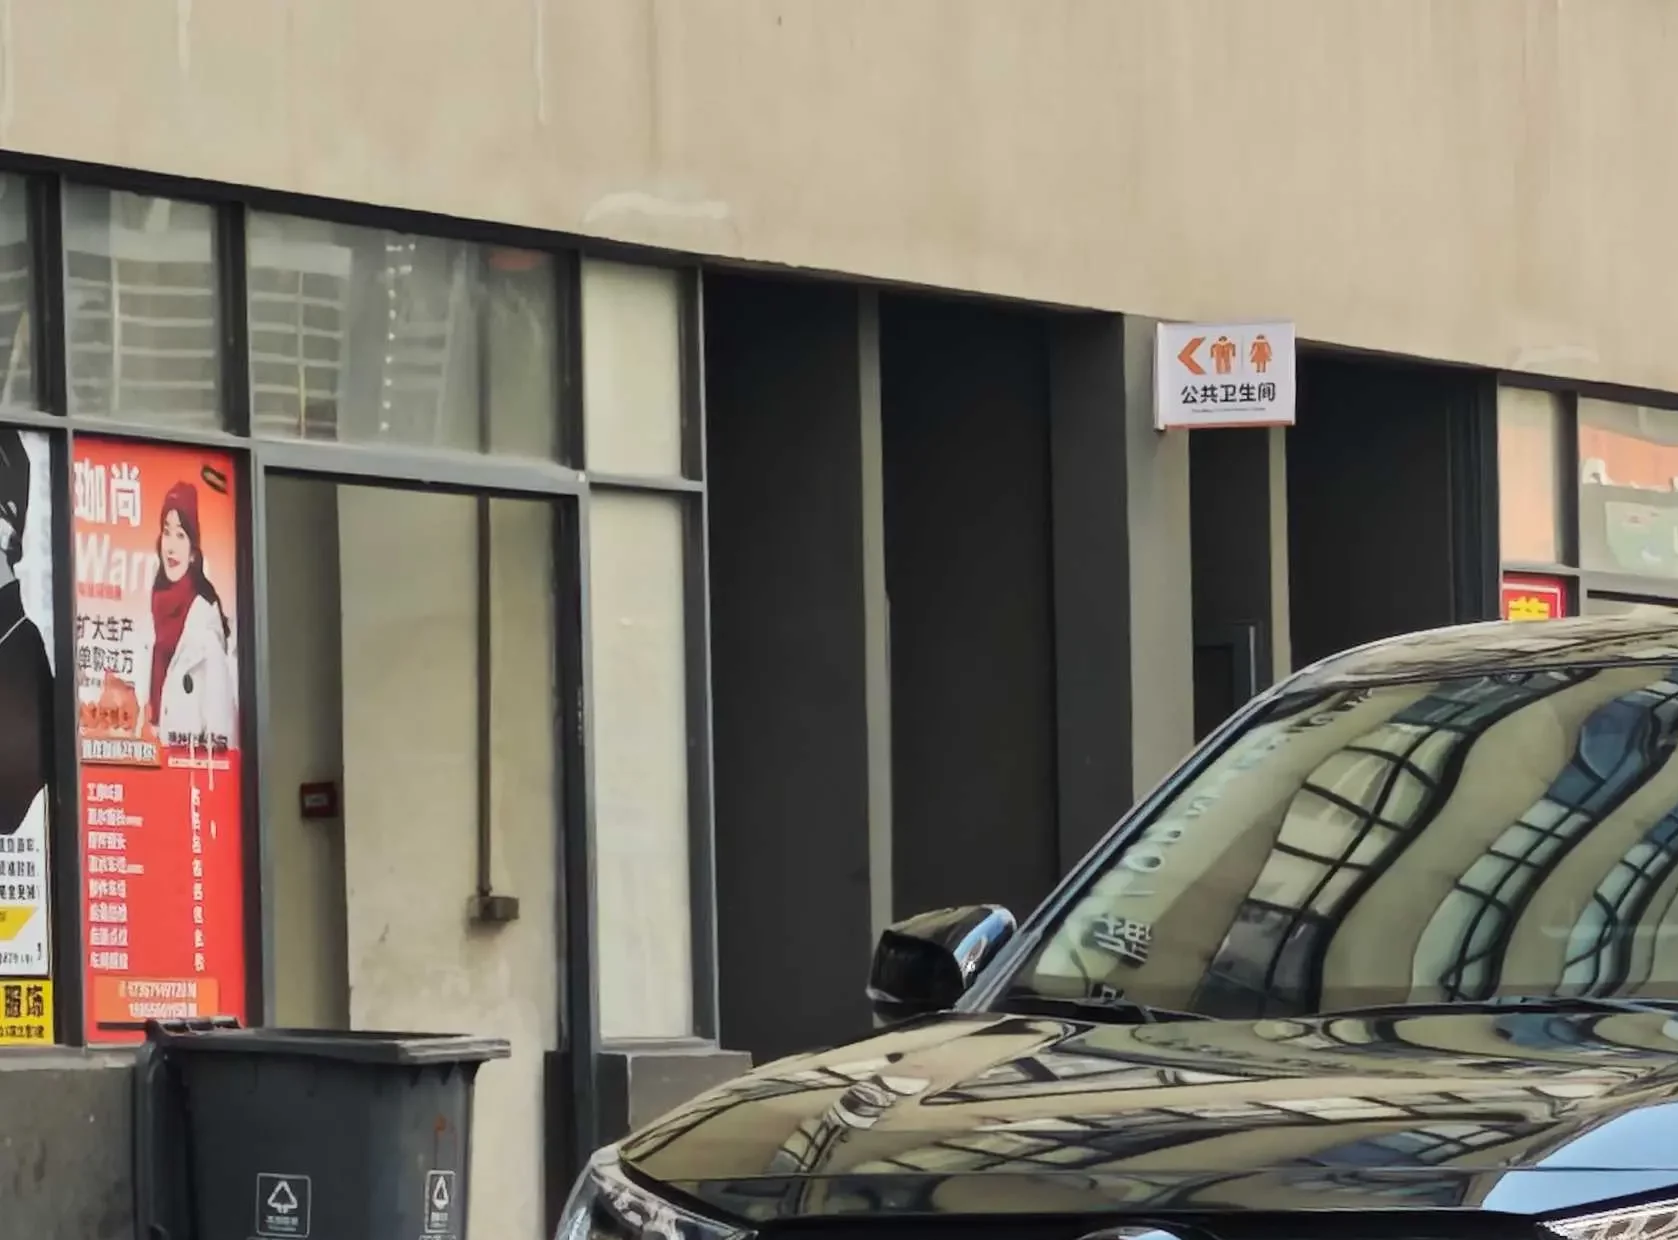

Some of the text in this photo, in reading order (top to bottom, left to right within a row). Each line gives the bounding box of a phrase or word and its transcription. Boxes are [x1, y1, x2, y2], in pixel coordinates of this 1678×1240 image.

[1181, 382, 1276, 404] 公共卫生间
